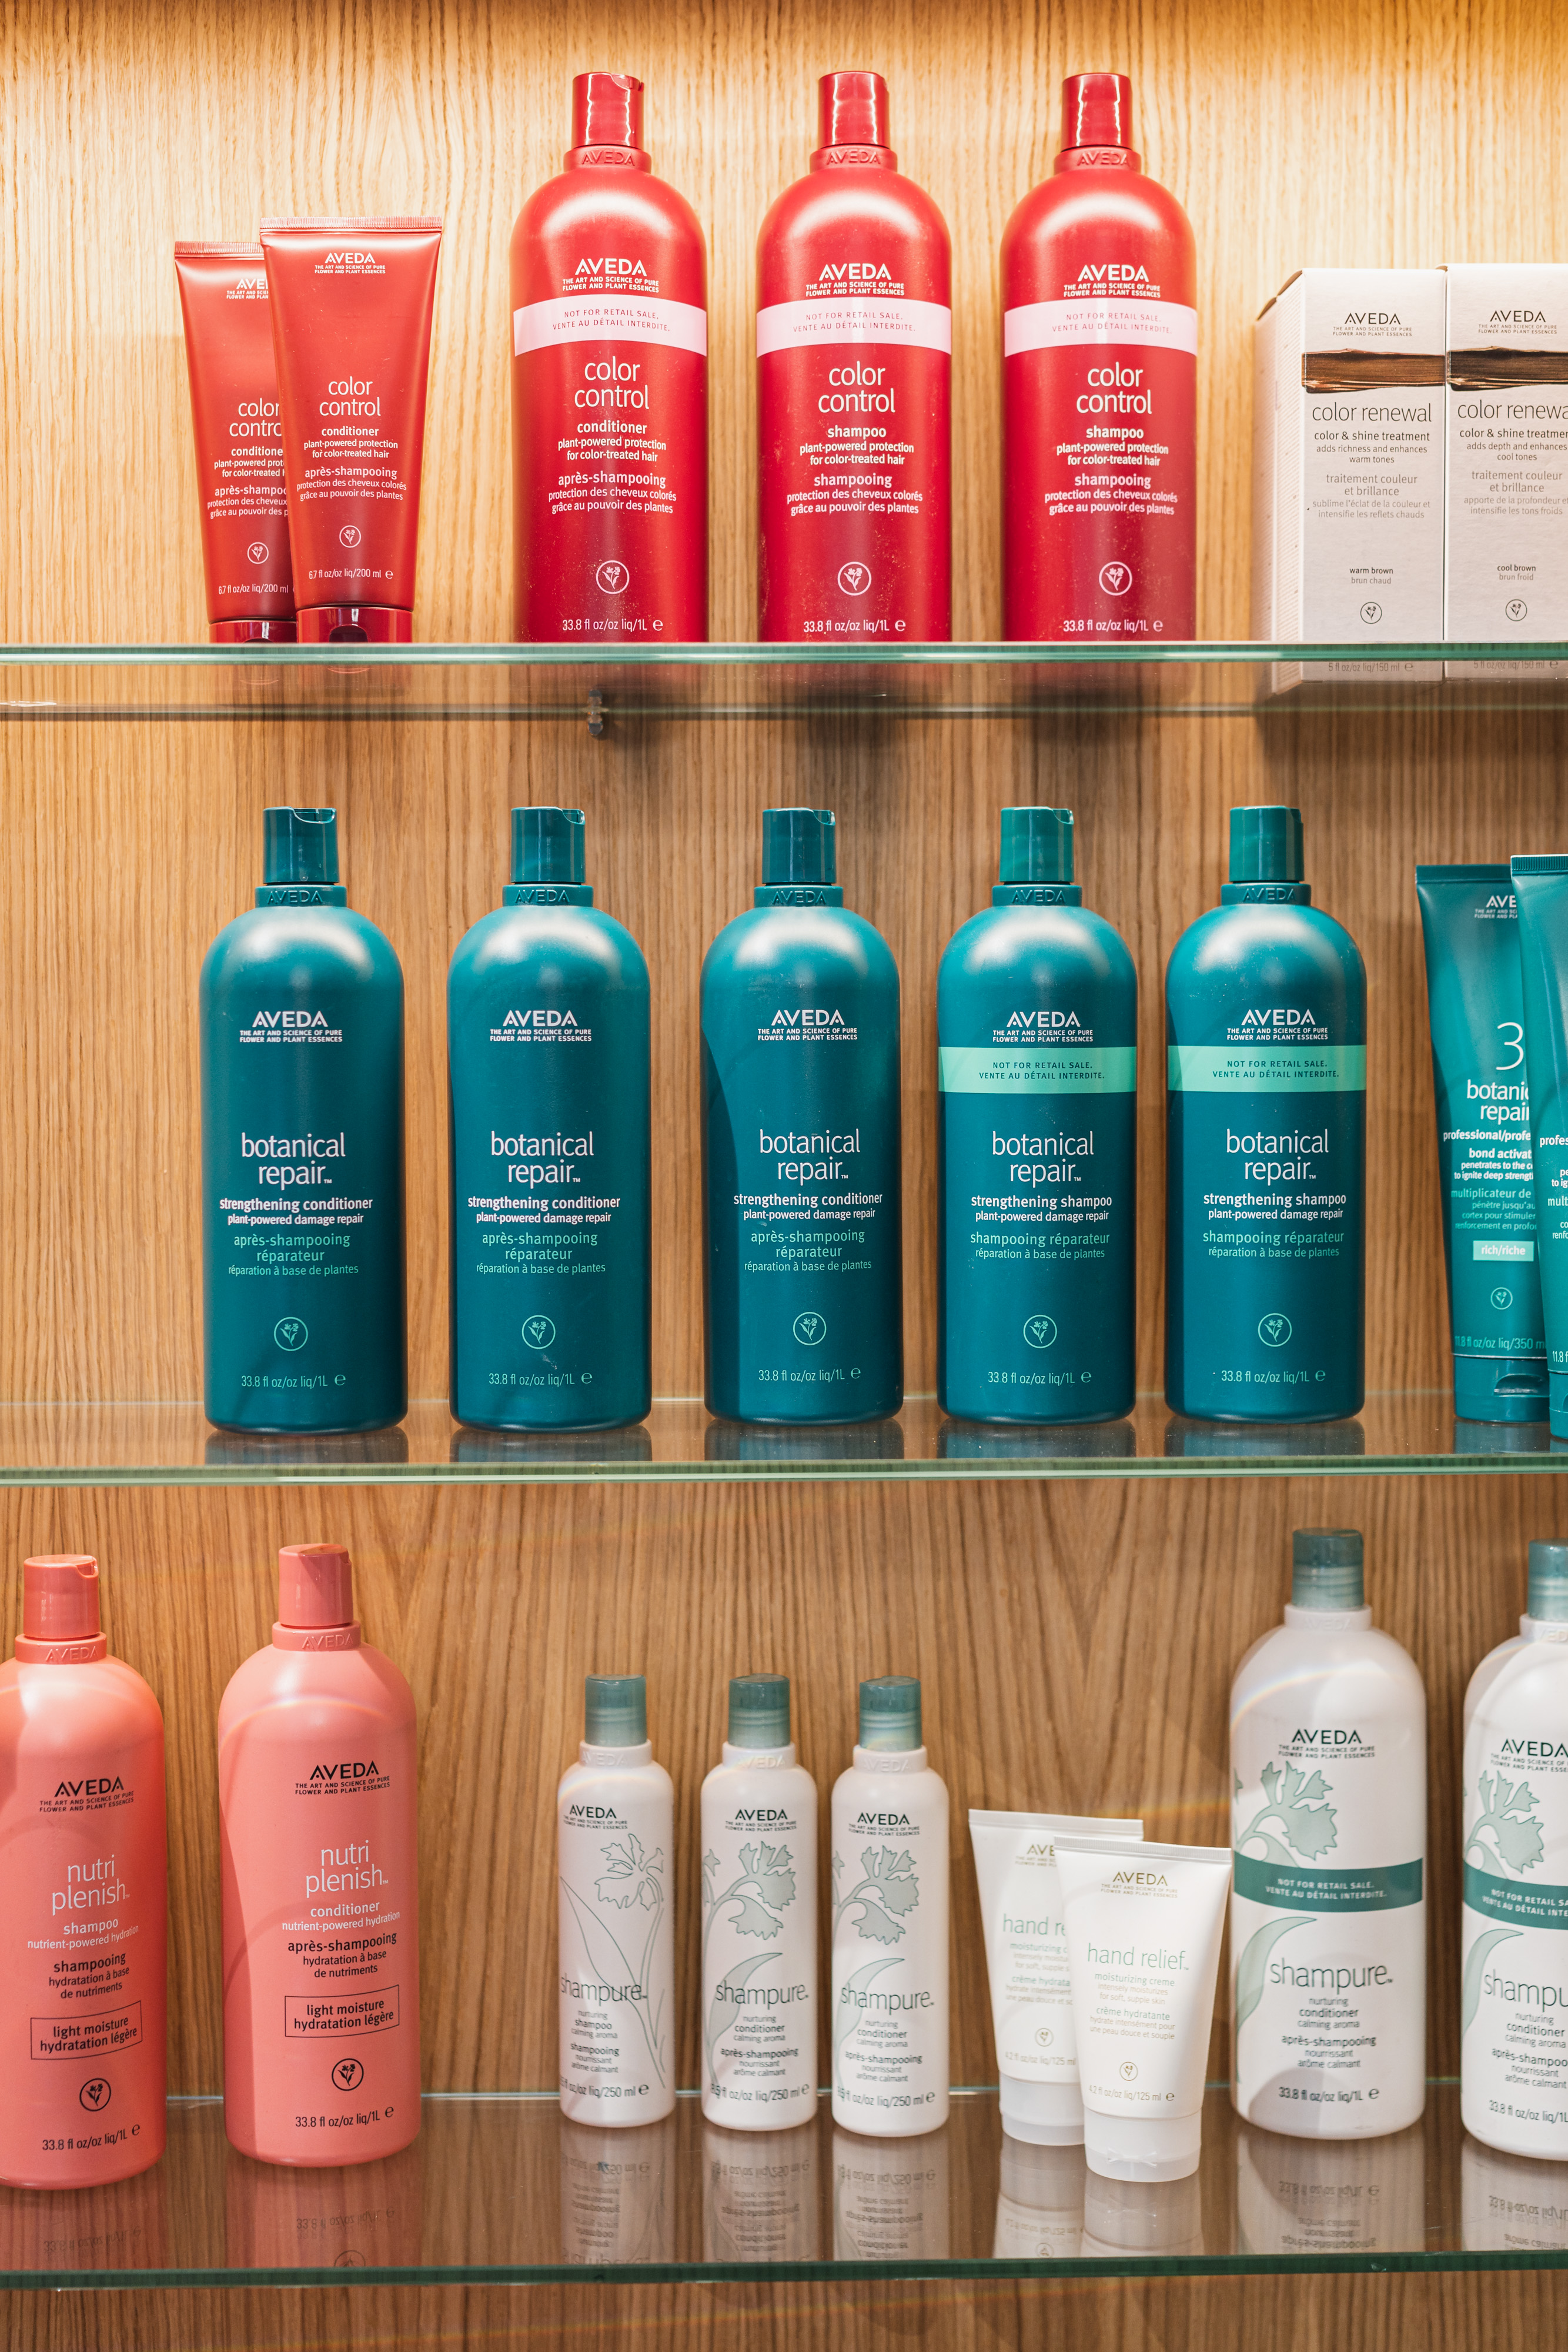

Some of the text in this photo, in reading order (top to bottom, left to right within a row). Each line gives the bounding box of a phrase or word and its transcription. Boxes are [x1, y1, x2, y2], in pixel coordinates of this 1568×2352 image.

[581, 150, 635, 166] AVEDA
[825, 151, 881, 166] AVEDA
[1076, 152, 1132, 167] AVEDA
[325, 252, 376, 264] AVEDA
[574, 258, 647, 277] AVEDA
[818, 263, 892, 282] AVEDA
[1077, 264, 1149, 282] AVEDA
[236, 278, 269, 290] AVE
[1345, 312, 1401, 325] AVEDA
[1490, 310, 1546, 323] AVEDA
[793, 324, 817, 332] VENTE
[584, 356, 641, 382] color
[828, 360, 886, 386] color
[1087, 361, 1144, 387] color
[328, 376, 373, 395] color
[574, 385, 650, 410] control
[818, 387, 895, 413] control
[1076, 389, 1152, 415] control
[319, 396, 381, 416] control
[1312, 402, 1432, 422] color renewal
[1457, 399, 1568, 419] color renewa
[229, 419, 282, 437] contro
[321, 426, 379, 436] conditioner
[577, 420, 647, 435] conditioner
[827, 425, 887, 440] shampoo
[1086, 425, 1144, 441] shampoo
[1314, 430, 1430, 441] color & shine treatment
[231, 446, 283, 456] conditione
[1057, 442, 1169, 456] plant-powered protection
[1338, 445, 1371, 453] richness
[1373, 445, 1388, 453] and
[1389, 445, 1427, 453] enhances
[1466, 442, 1567, 452] adds depth and enhances
[1497, 452, 1513, 460] cool
[222, 469, 280, 477] for color-treated
[305, 465, 398, 480] après-shampooing
[814, 472, 892, 489] shampooing
[1326, 473, 1418, 484] traitement couleur
[1517, 573, 1534, 581] froid
[227, 584, 232, 593] fl
[232, 584, 250, 594] oz/oz
[280, 584, 289, 593] ml
[266, 890, 324, 905] AVEDA
[1242, 887, 1298, 902] AVEDA
[252, 1010, 329, 1028] AVEDA
[502, 1010, 578, 1028] AVEDA
[771, 1008, 845, 1027] AVEDA
[1006, 1011, 1081, 1028] AVEDA
[1241, 1008, 1316, 1026] AVEDA
[1496, 1022, 1524, 1070] 3
[1466, 1079, 1529, 1101] botani
[242, 1132, 346, 1158] botanical
[491, 1130, 594, 1157] botanical
[760, 1128, 861, 1154] botanical
[992, 1130, 1094, 1156] botanical
[1226, 1128, 1329, 1154] botanical
[1469, 1148, 1496, 1161] bond
[219, 1197, 373, 1213] strengthening conditioner
[971, 1195, 1112, 1210] strengthening shampoo
[1485, 1212, 1503, 1221] pour
[1503, 1212, 1536, 1221] stimuler
[751, 1229, 865, 1245] après-shampooing
[1202, 1230, 1345, 1246] shampooing réparateur
[775, 1245, 842, 1261] réparateur
[1481, 1244, 1526, 1257] rich/riche
[476, 1262, 606, 1275] réparation à base de plantes
[241, 1375, 260, 1387] 33.8
[262, 1375, 269, 1387] fl
[271, 1375, 297, 1389] oz/oz
[302, 1633, 353, 1649] AVEDA
[44, 1645, 99, 1662] AVEDA
[1292, 1729, 1362, 1745] AVEDA
[1501, 1739, 1568, 1758] AVEDA
[309, 1760, 379, 1780] AVEDA
[54, 1776, 125, 1798] AVEDA
[570, 1805, 617, 1819] AVEDA
[735, 1809, 788, 1821] AVEDA
[857, 1812, 910, 1825] AVEDA
[321, 1839, 369, 1866] nutri
[1027, 1844, 1055, 1857] AVE
[68, 1854, 115, 1883] nutri
[1112, 1872, 1168, 1886] AVEDA
[310, 1902, 380, 1917] conditioner
[63, 1919, 119, 1935] shampoo
[1003, 1913, 1049, 1936] hand
[287, 1933, 397, 1955] après-shampooing
[1088, 1942, 1135, 1966] hand
[1095, 1972, 1175, 1987] moisturizing creme
[1484, 1968, 1568, 2013] shampu
[1096, 2007, 1171, 2021] crème hydratante
[1299, 2009, 1359, 2018] conditioner
[53, 2017, 129, 2040] light moisture
[574, 2018, 613, 2030] shampoo
[734, 2025, 785, 2033] conditioner
[1506, 2023, 1566, 2037] conditioner
[40, 2027, 137, 2054] hydratation légère
[857, 2029, 908, 2039] conditioner
